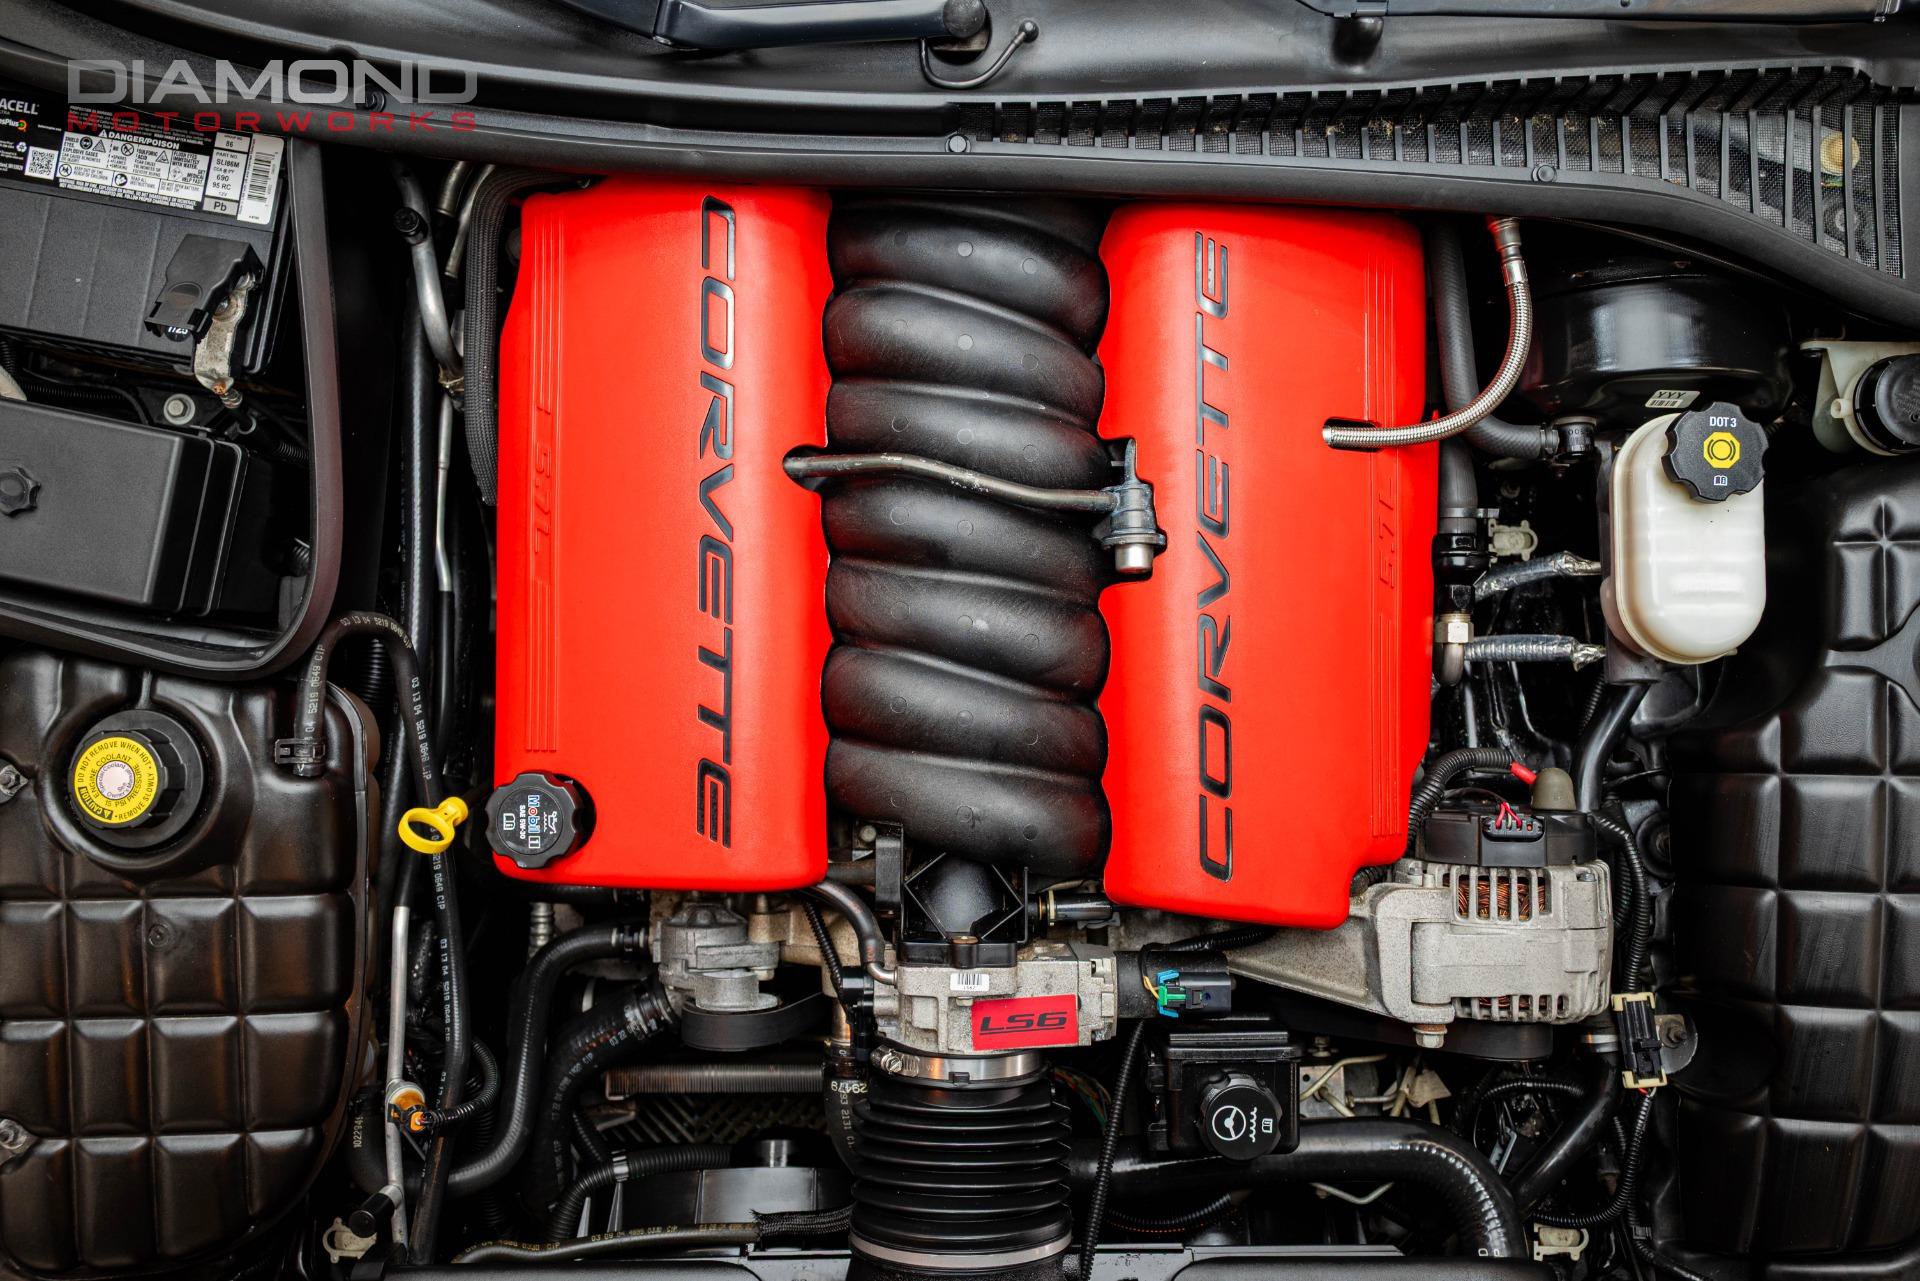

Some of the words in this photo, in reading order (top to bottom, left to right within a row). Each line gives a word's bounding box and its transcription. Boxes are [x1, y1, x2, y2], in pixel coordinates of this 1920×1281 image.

[107, 131, 179, 149] DANGER/POISON
[214, 202, 227, 211] Pb
[1710, 416, 1728, 427] DOT
[1730, 417, 1736, 427] 3
[697, 195, 735, 848] CORVETTE
[1195, 231, 1232, 882] CORVETTE
[308, 692, 318, 714] 5219
[314, 644, 326, 661] CIP
[412, 676, 419, 688] 03
[412, 692, 421, 702] 13
[414, 704, 422, 715] 04
[416, 720, 426, 740] 5219
[89, 741, 118, 757] REMOVE
[120, 742, 141, 754] WHEN
[80, 756, 91, 771] NOT
[140, 753, 151, 766] HOT
[78, 772, 84, 782] DO
[89, 768, 100, 799] ENGINE
[96, 754, 132, 766] COOLANT
[127, 764, 142, 801] PRESSURE
[80, 787, 103, 814] CAUTION
[118, 802, 145, 820] REMOVE
[143, 772, 154, 801] SLOWLY
[528, 795, 540, 833] Mobil
[436, 895, 445, 910] CIP
[440, 938, 448, 949] 03
[442, 965, 448, 976] 04
[980, 1011, 1068, 1032] LS6
